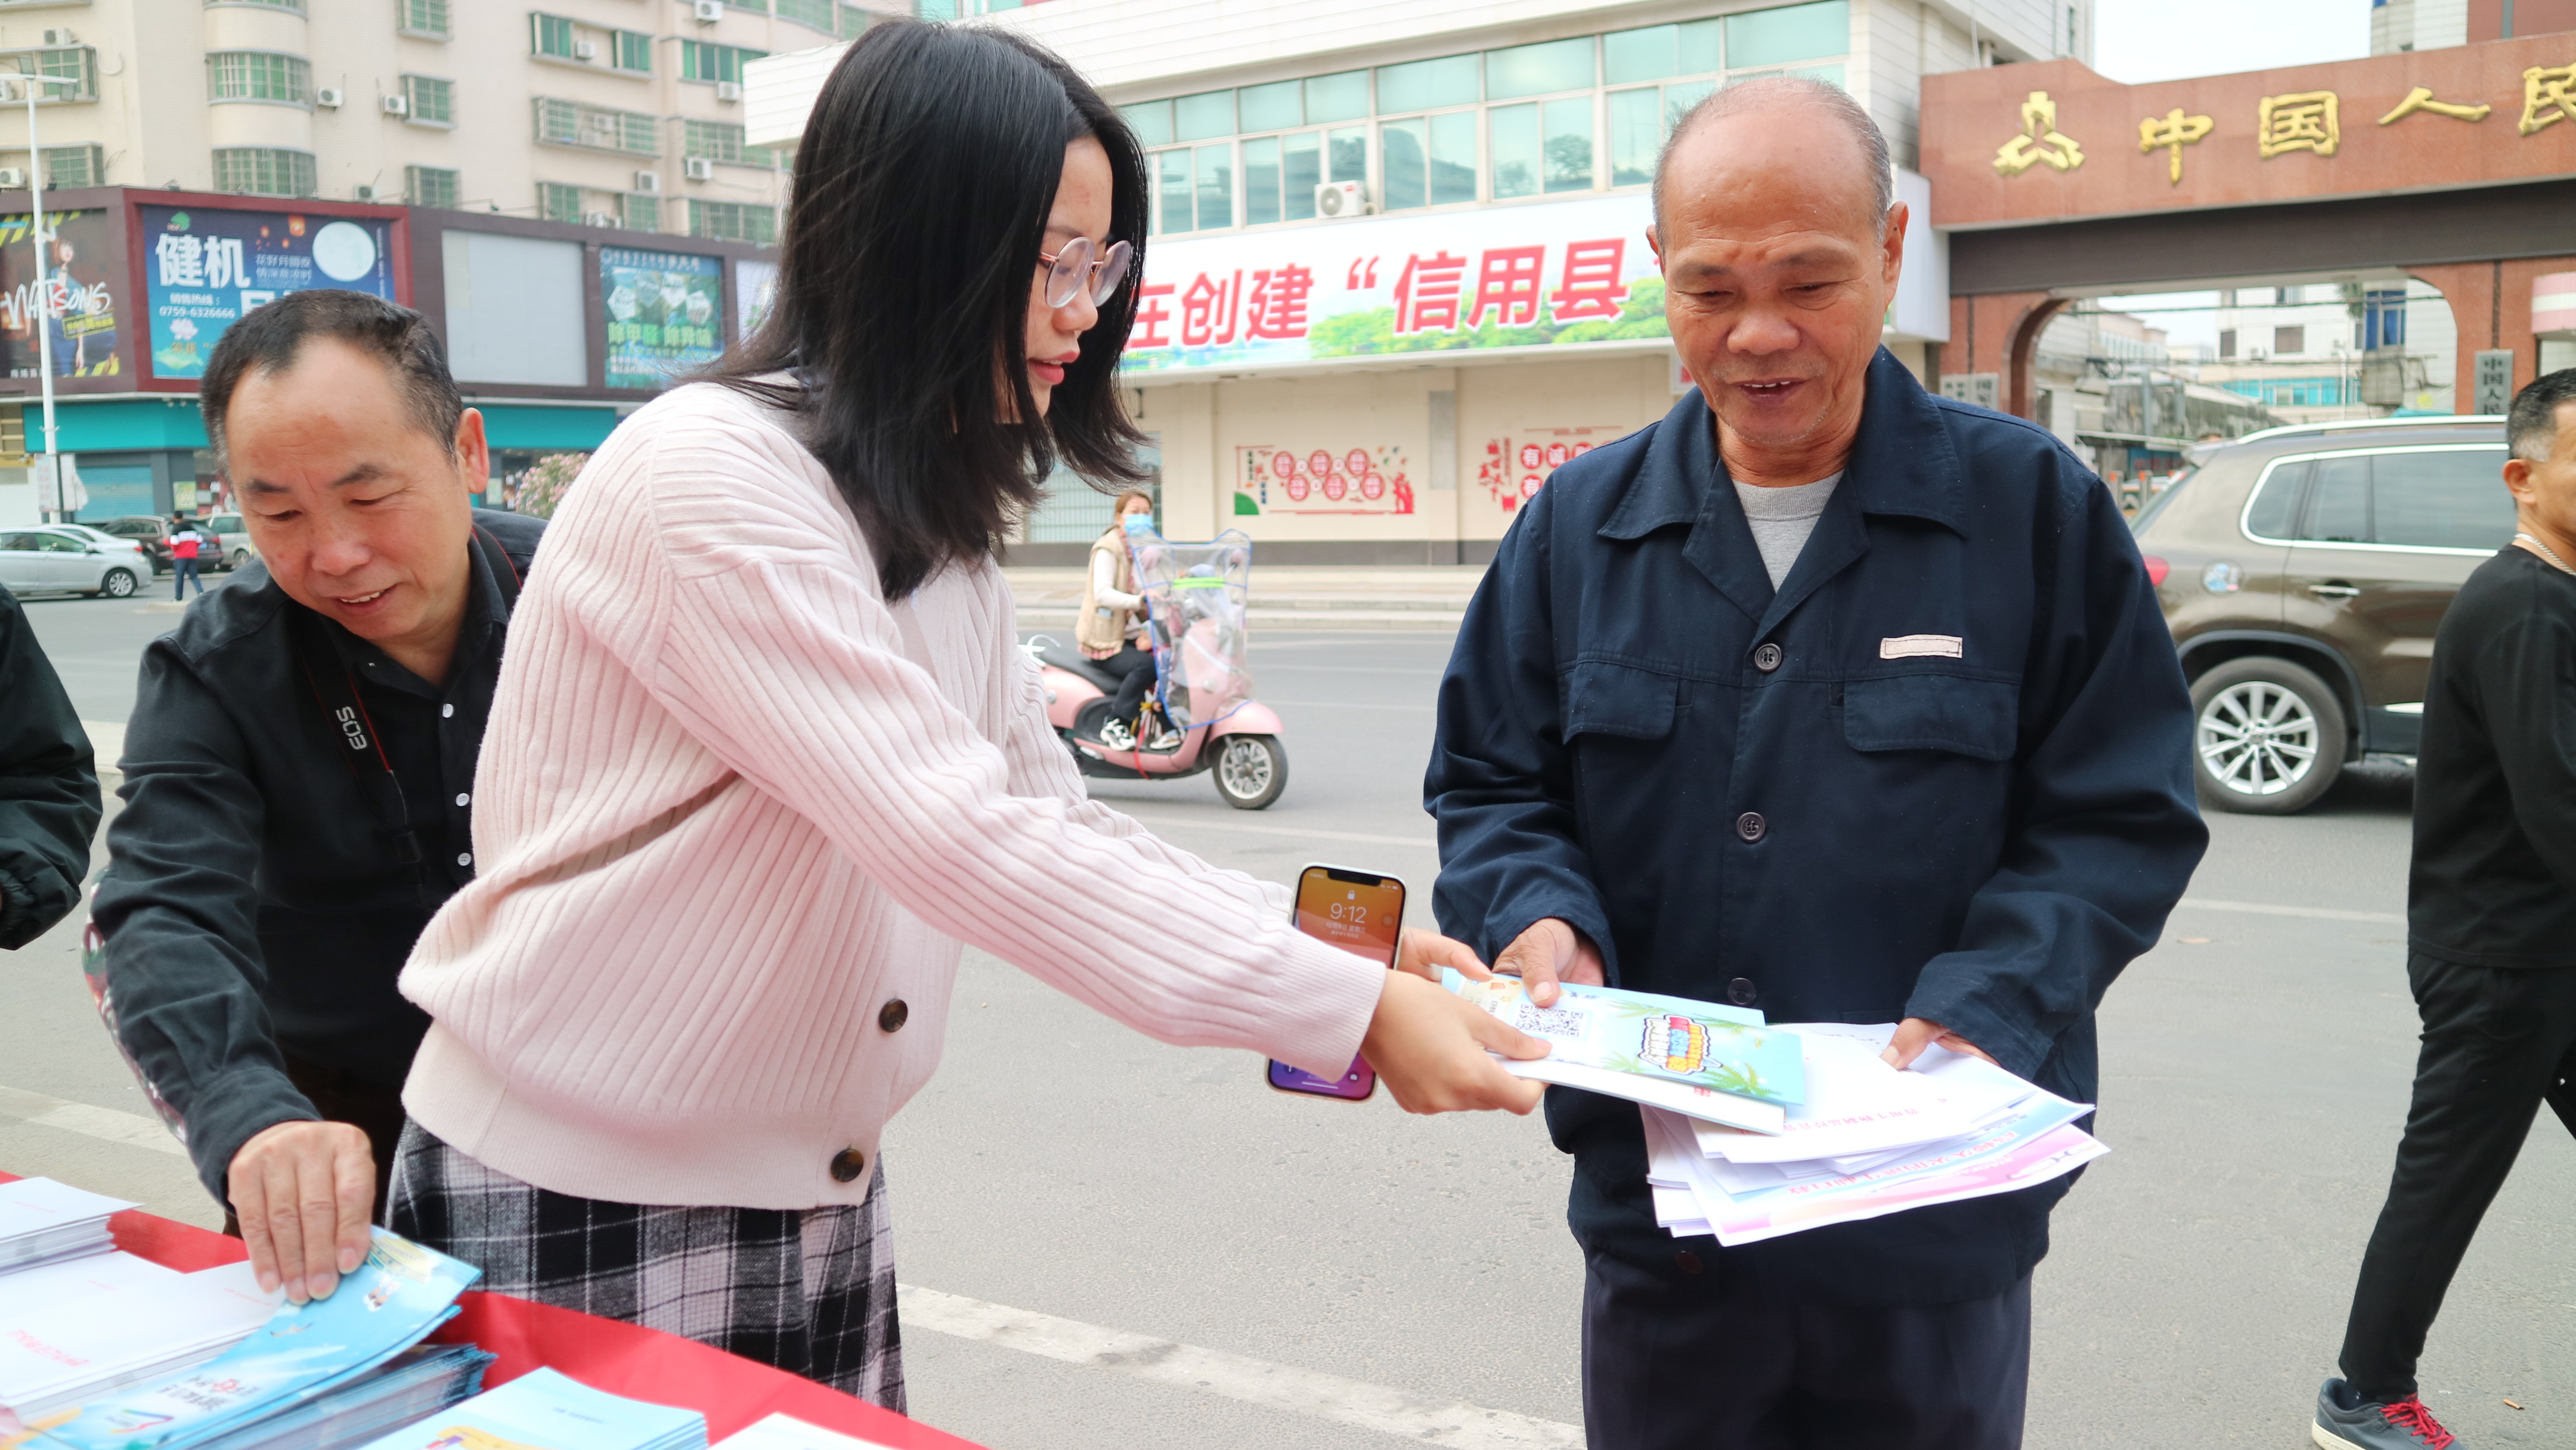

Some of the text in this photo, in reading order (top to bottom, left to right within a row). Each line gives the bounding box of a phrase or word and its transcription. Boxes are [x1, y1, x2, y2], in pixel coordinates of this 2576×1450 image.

[2139, 61, 2576, 187] 中国人民
[155, 233, 252, 290] 健机
[159, 305, 236, 319] 0759-6326666
[1123, 237, 1660, 351] 在创建“信用县
[336, 706, 368, 750] EOS
[1330, 902, 1367, 924] 9:12
